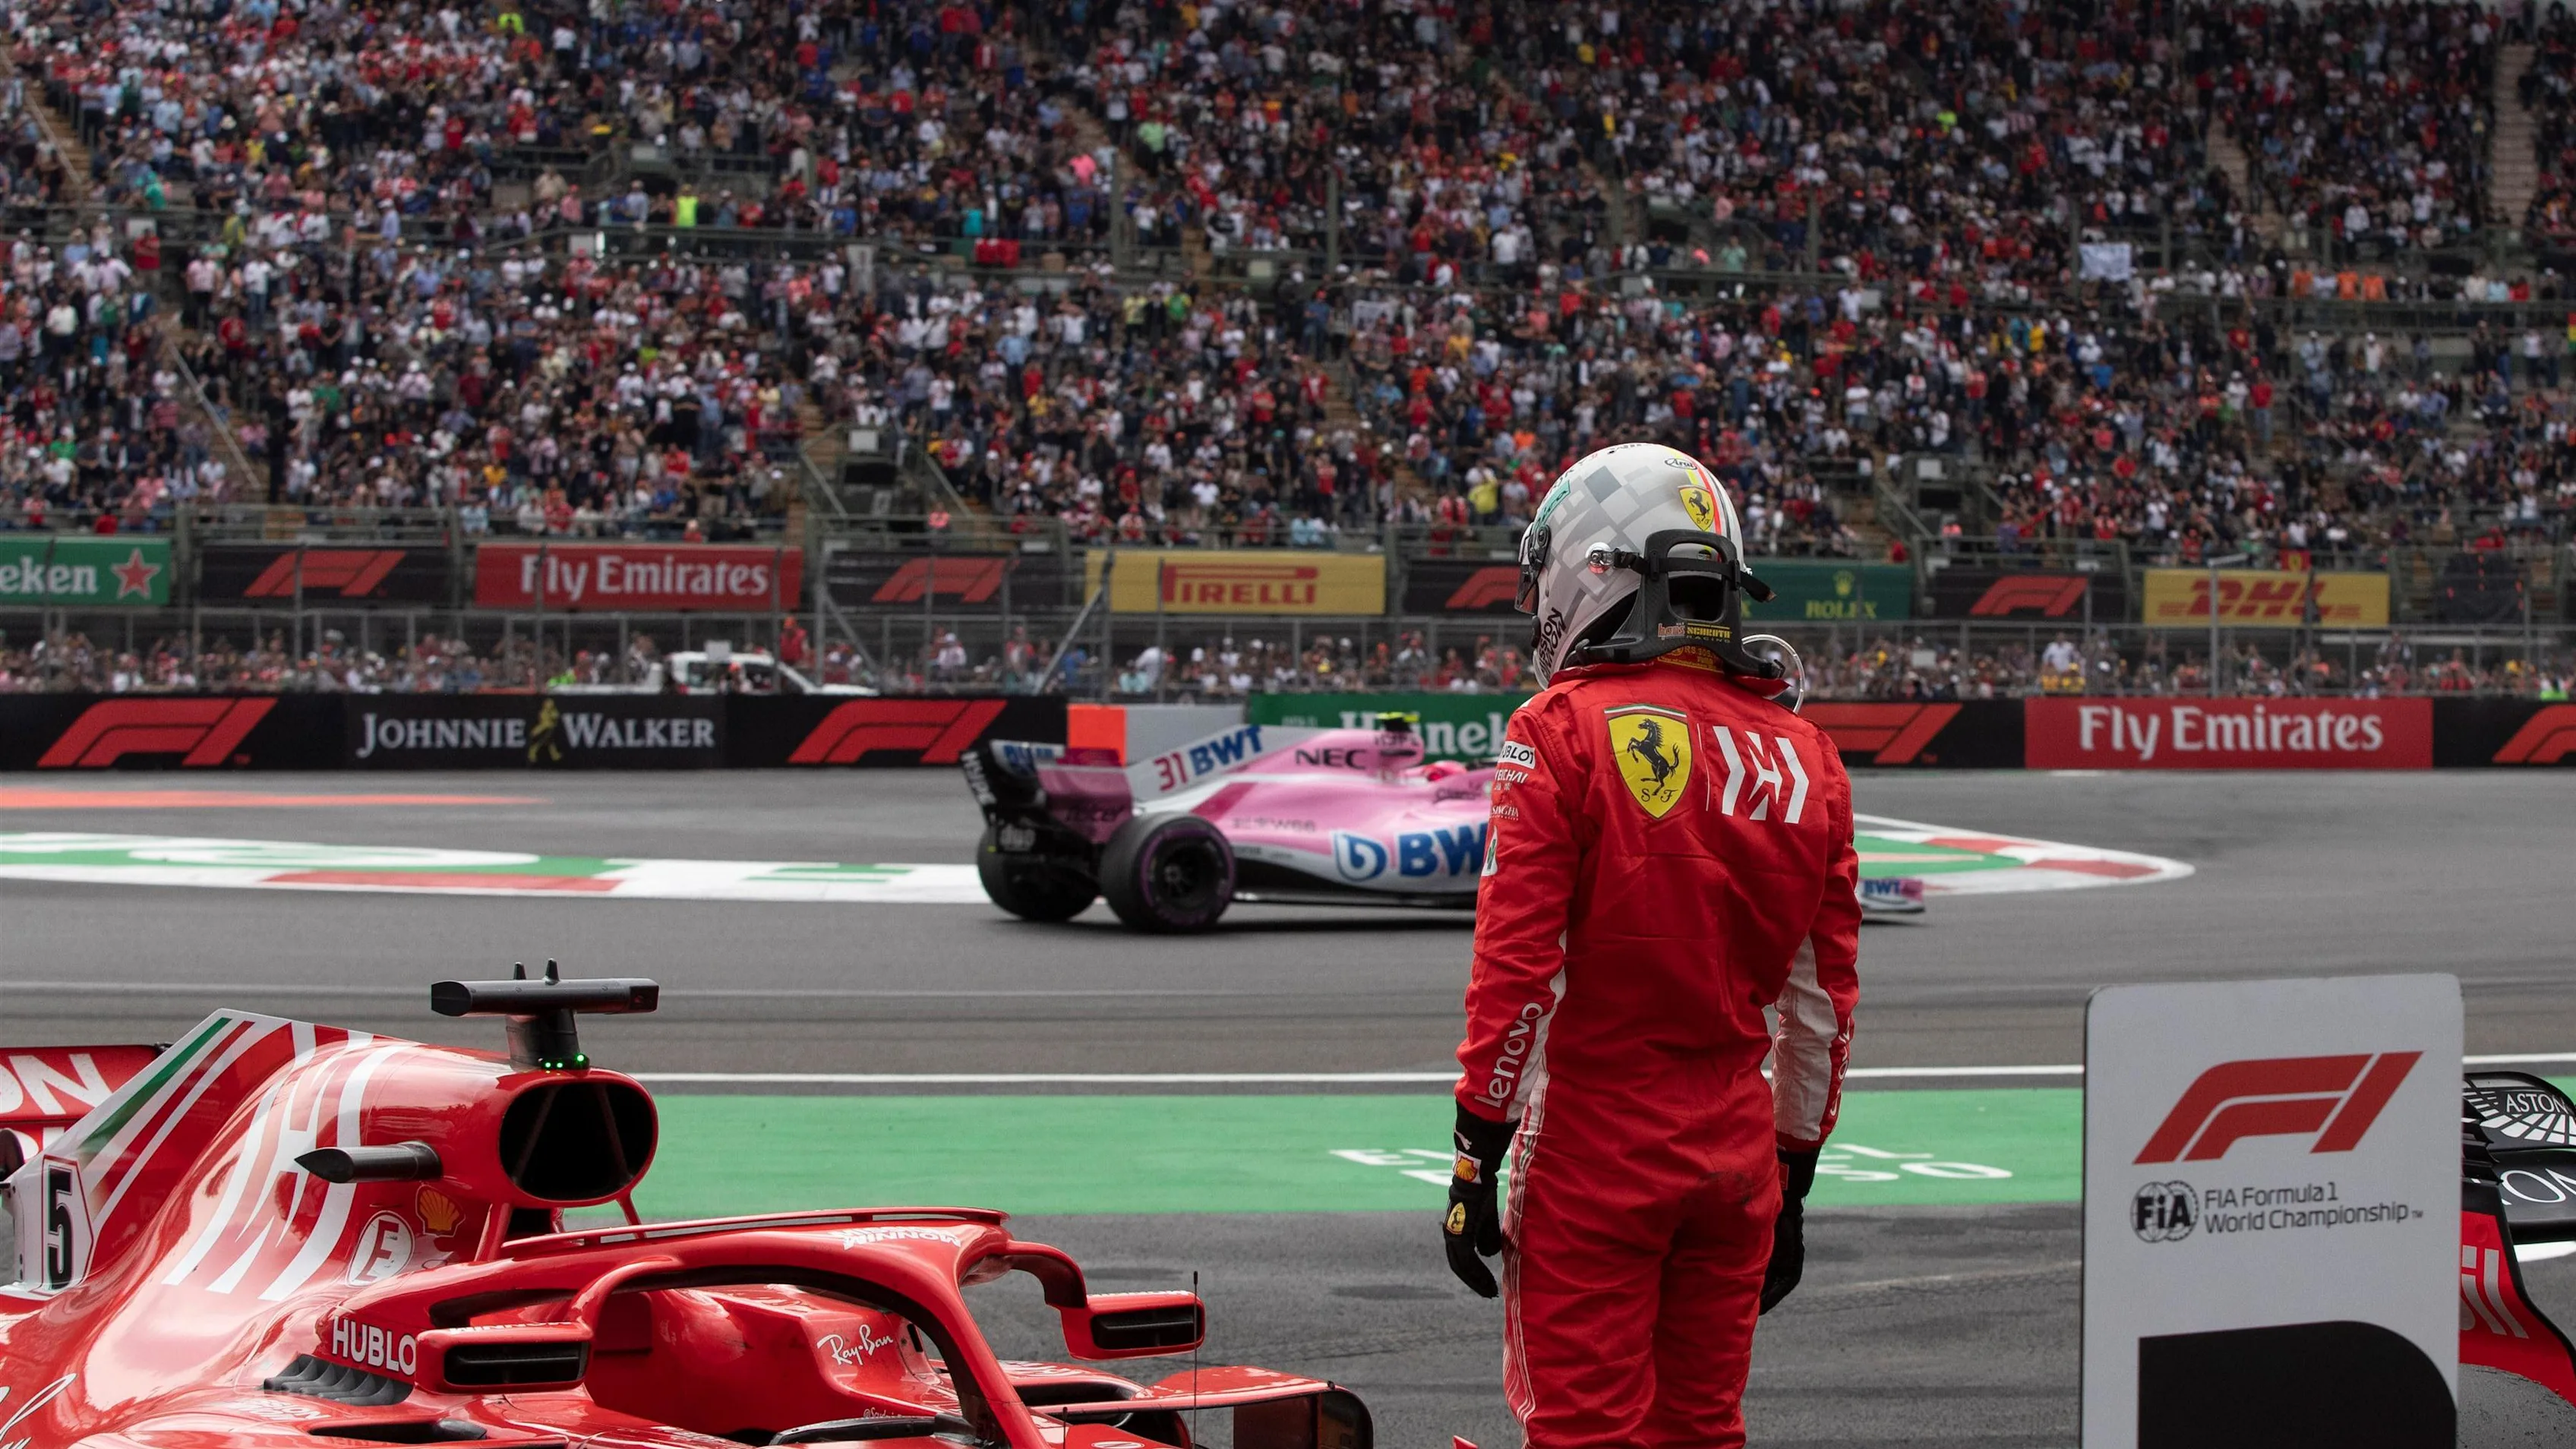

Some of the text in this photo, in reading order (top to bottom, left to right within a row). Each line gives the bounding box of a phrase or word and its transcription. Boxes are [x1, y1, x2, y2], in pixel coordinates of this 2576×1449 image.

[521, 555, 769, 600] Fly Emirates
[1162, 565, 1318, 605] PIRELLI
[2186, 579, 2333, 617] DHL
[1687, 627, 1731, 639] SCHROTH
[356, 713, 715, 758] JOHNNIE WALKER
[2079, 706, 2384, 760] Fly Emirates
[1154, 724, 1262, 791] 31 BWT
[1296, 749, 1367, 770] NEC
[1397, 822, 1489, 877] BW
[1475, 1002, 1543, 1108] Lenovo
[2132, 1050, 2425, 1165] F1
[2205, 1182, 2338, 1209] FIA Formula 1
[2205, 1211, 2265, 1233] World
[2269, 1201, 2409, 1229] Championship
[47, 1165, 73, 1290] 5
[332, 1315, 417, 1376] HUBLO
